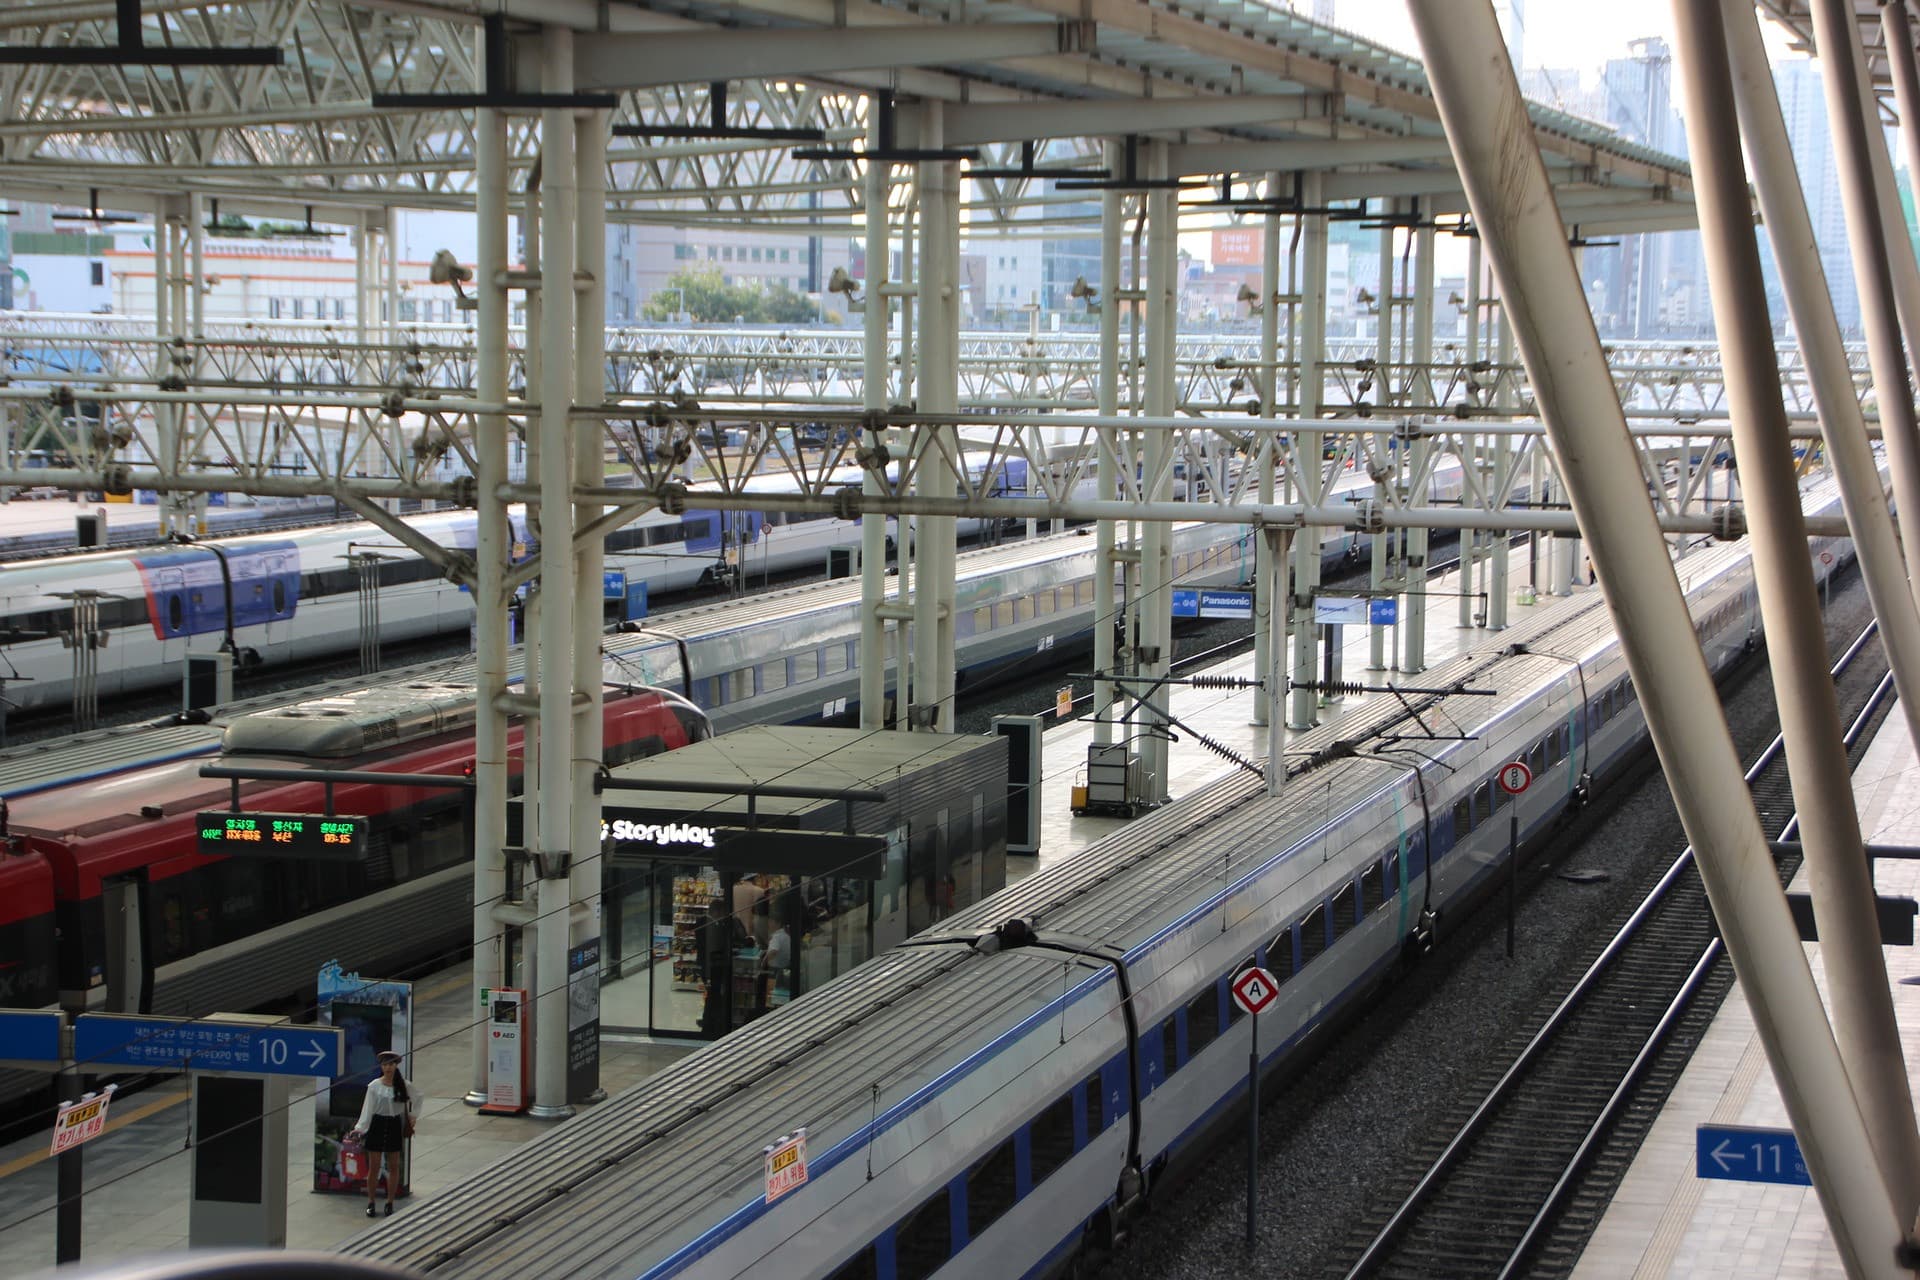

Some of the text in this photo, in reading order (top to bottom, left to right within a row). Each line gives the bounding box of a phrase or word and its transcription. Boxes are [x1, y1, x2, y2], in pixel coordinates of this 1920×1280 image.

[1202, 596, 1250, 606] Panasonic
[1249, 981, 1261, 996] A
[259, 1038, 288, 1065] 10
[1751, 1143, 1780, 1174] 11
